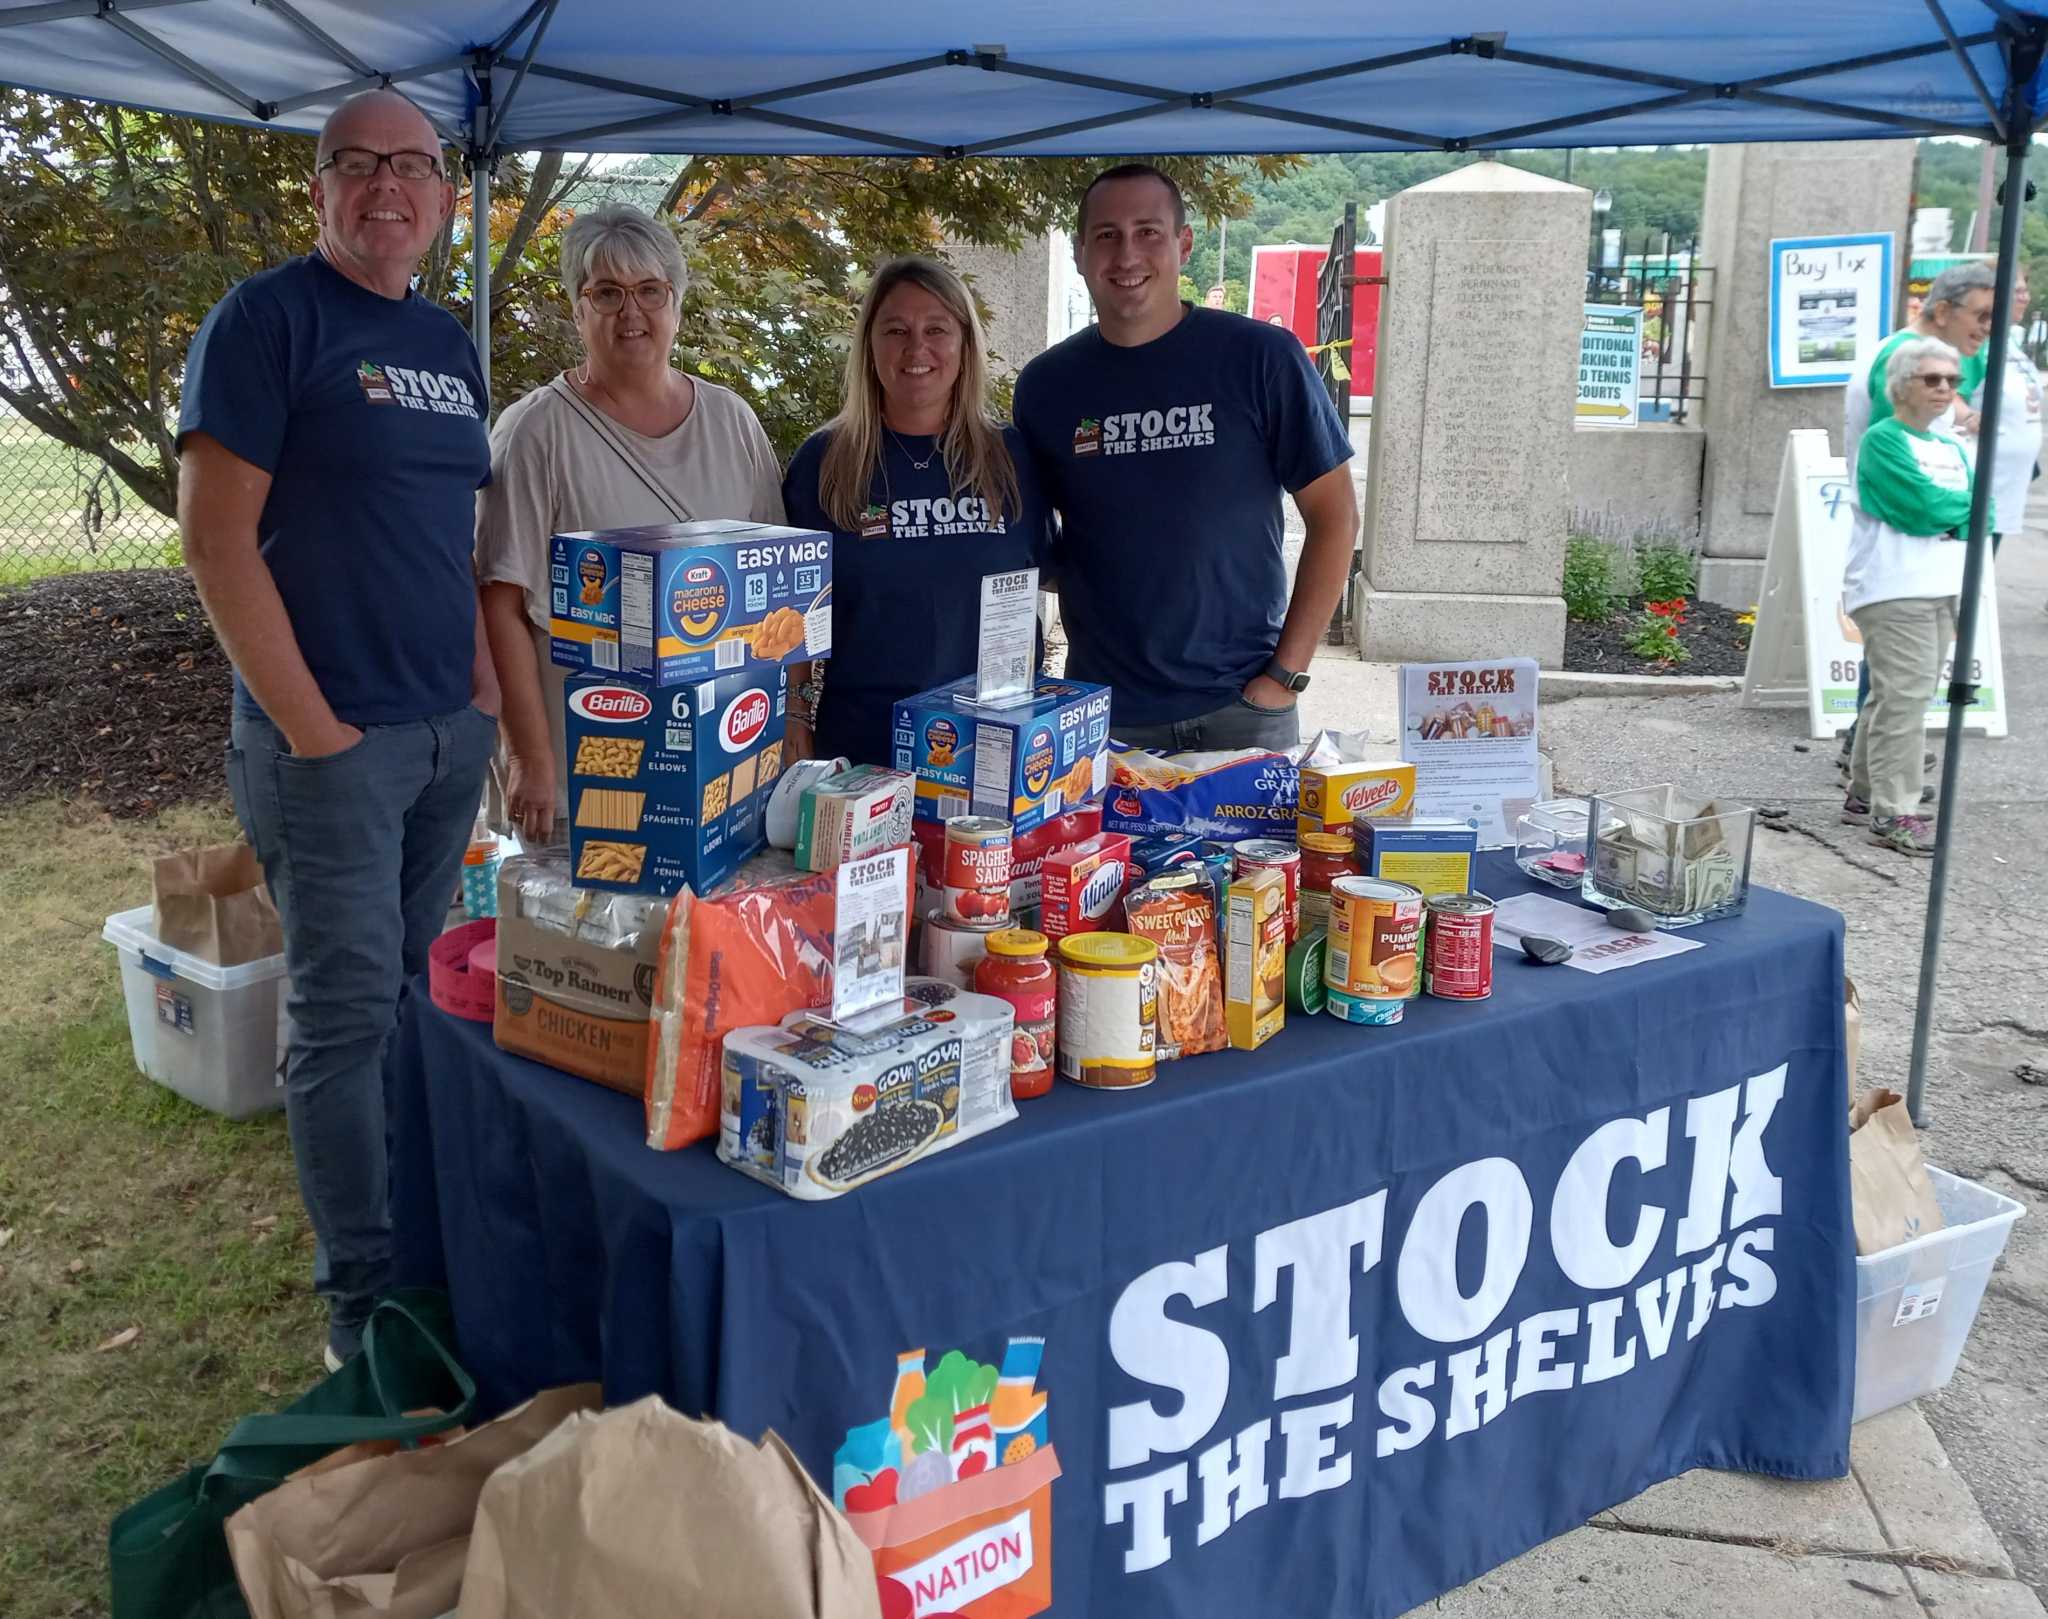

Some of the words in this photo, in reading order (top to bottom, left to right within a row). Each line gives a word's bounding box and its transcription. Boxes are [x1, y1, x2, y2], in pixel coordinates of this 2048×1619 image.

[1786, 251, 1827, 281] Buy
[1582, 337, 1634, 352] DITIONAL
[1581, 353, 1618, 367] RKING
[1620, 355, 1633, 368] IN
[385, 365, 475, 406] STOCK
[1591, 369, 1632, 384] TENNIS
[395, 394, 429, 411] THE
[429, 399, 479, 420] SHELVES
[1104, 403, 1214, 441] STOCK
[1104, 441, 1137, 455] THE
[1141, 432, 1215, 452] SHELVES
[893, 525, 929, 539] THE
[749, 579, 764, 596] 18
[992, 573, 1028, 588] STOCK
[555, 591, 566, 604] 18
[674, 587, 717, 600] macaroni
[779, 665, 787, 685] 6
[1428, 669, 1515, 689] STOCK
[1830, 661, 1858, 682] 86
[1428, 686, 1455, 696] THE
[1458, 685, 1515, 695] SHELVES
[587, 694, 645, 713] Barilla
[671, 692, 690, 720] 6
[666, 720, 692, 728] Boxes
[731, 698, 766, 737] Barilla
[648, 762, 687, 772] ELBOWS
[899, 752, 909, 763] 18
[1263, 767, 1300, 779] MED
[1345, 779, 1399, 810] Velveeta
[642, 814, 694, 826] SPAGHETTI
[1214, 804, 1267, 820] ARROZ
[1268, 808, 1299, 820] GRA
[703, 834, 723, 856] ELBOWS
[961, 847, 1015, 867] SPAGHET
[653, 867, 685, 878] PENNE
[850, 857, 895, 879] STOCK
[976, 863, 1010, 884] SAUCE
[850, 878, 865, 888] THE
[1082, 861, 1124, 914] Minute
[1136, 913, 1174, 930] SWEET
[1381, 931, 1420, 943] PUMPK
[533, 959, 564, 987] Top
[568, 970, 633, 1003] Ramen
[537, 1008, 611, 1051] CHICKEN
[918, 1042, 960, 1073] GOYA
[878, 1065, 914, 1092] GOYA
[1107, 1063, 1789, 1470] STOCK
[1105, 1393, 1354, 1574] THE
[1375, 1227, 1777, 1459] SHELVES
